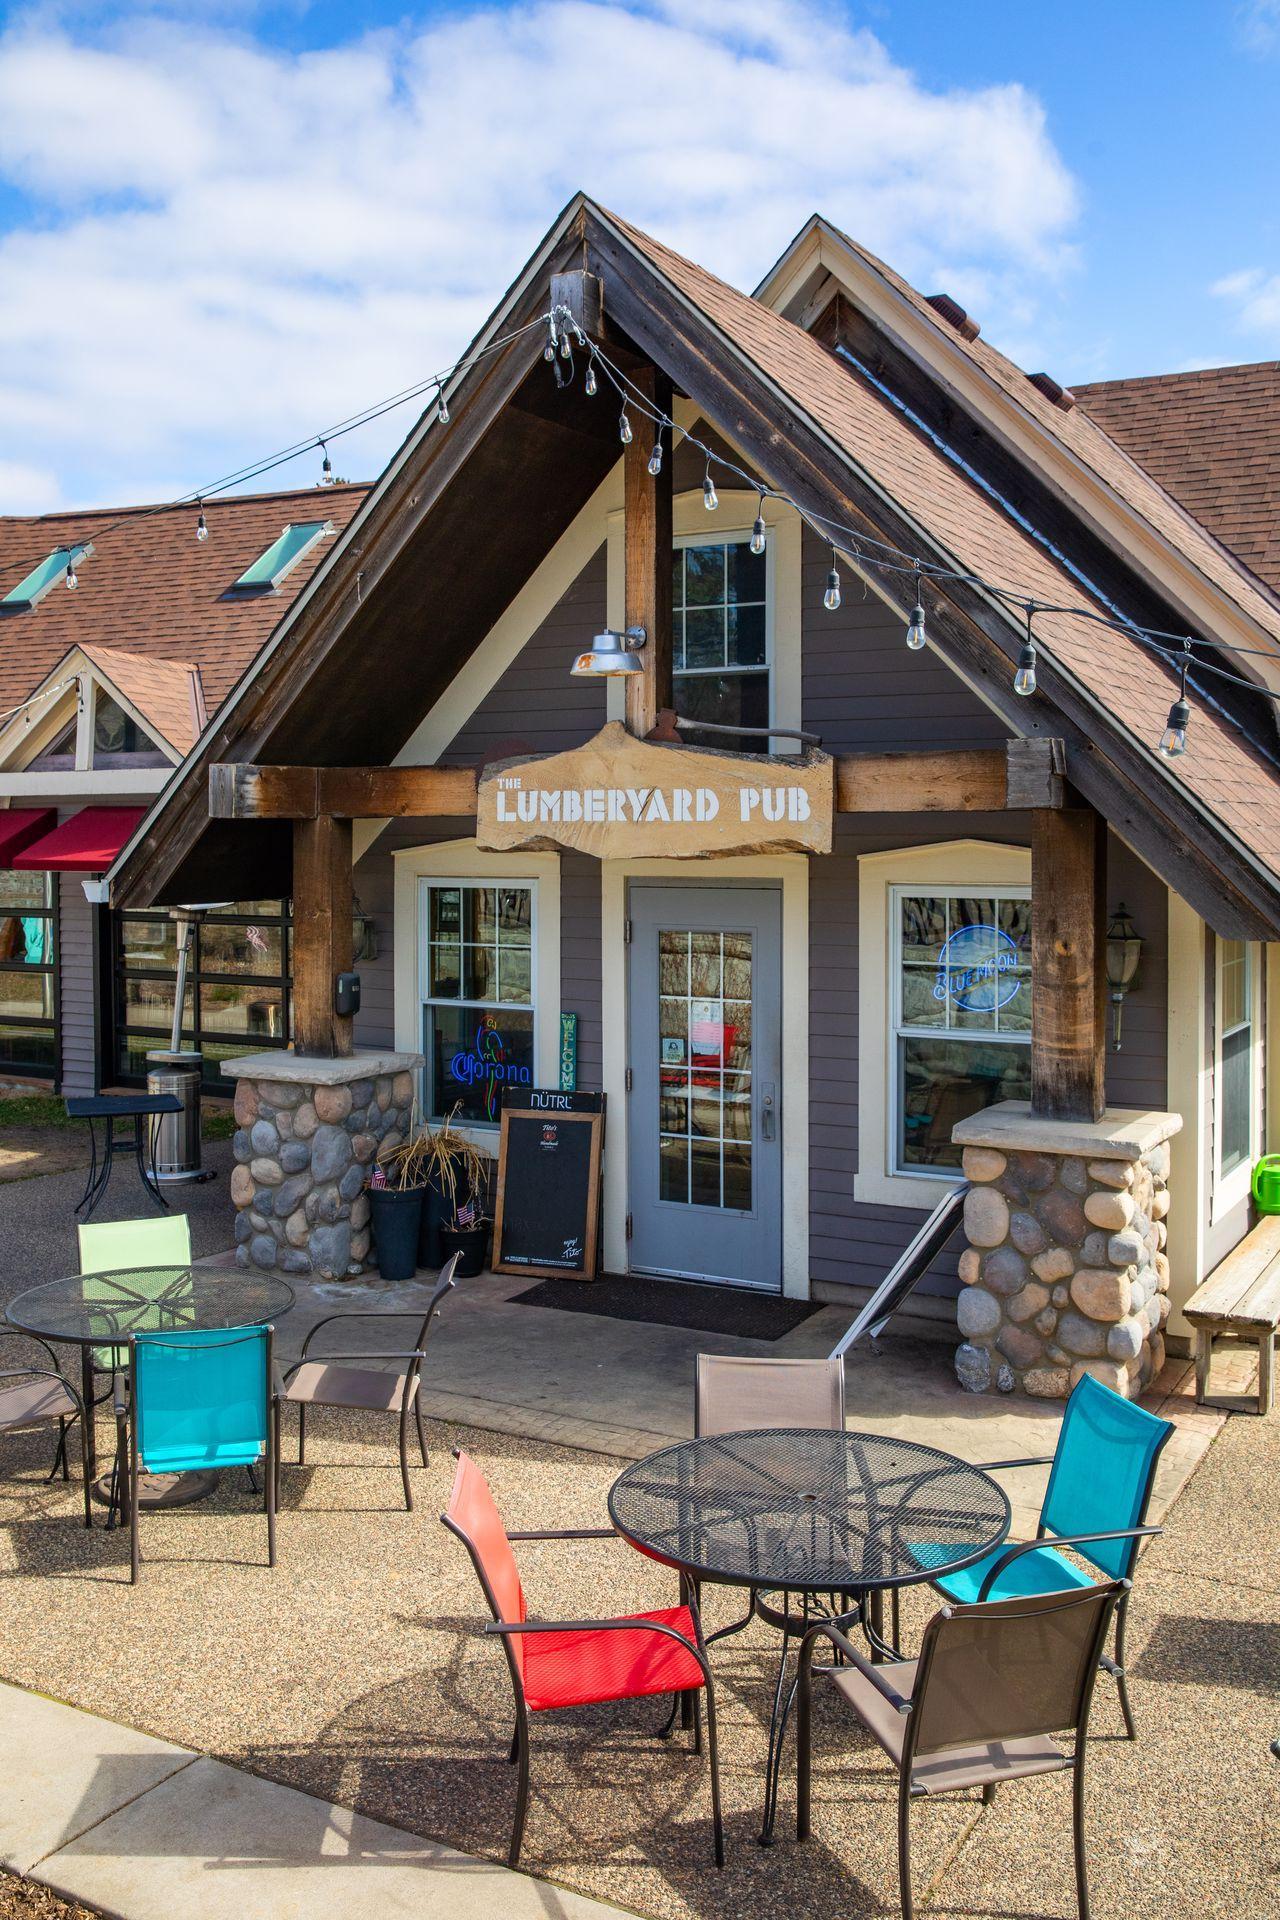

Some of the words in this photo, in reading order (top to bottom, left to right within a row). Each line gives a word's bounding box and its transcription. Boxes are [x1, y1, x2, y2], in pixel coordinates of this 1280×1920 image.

[497, 777, 522, 790] THE
[496, 787, 720, 823] LUMBERYARD
[740, 787, 811, 823] PUB
[933, 971, 973, 1000] BLUE
[974, 953, 1017, 982] MOON
[451, 1052, 530, 1086] Corona
[561, 1019, 575, 1091] WELCOME
